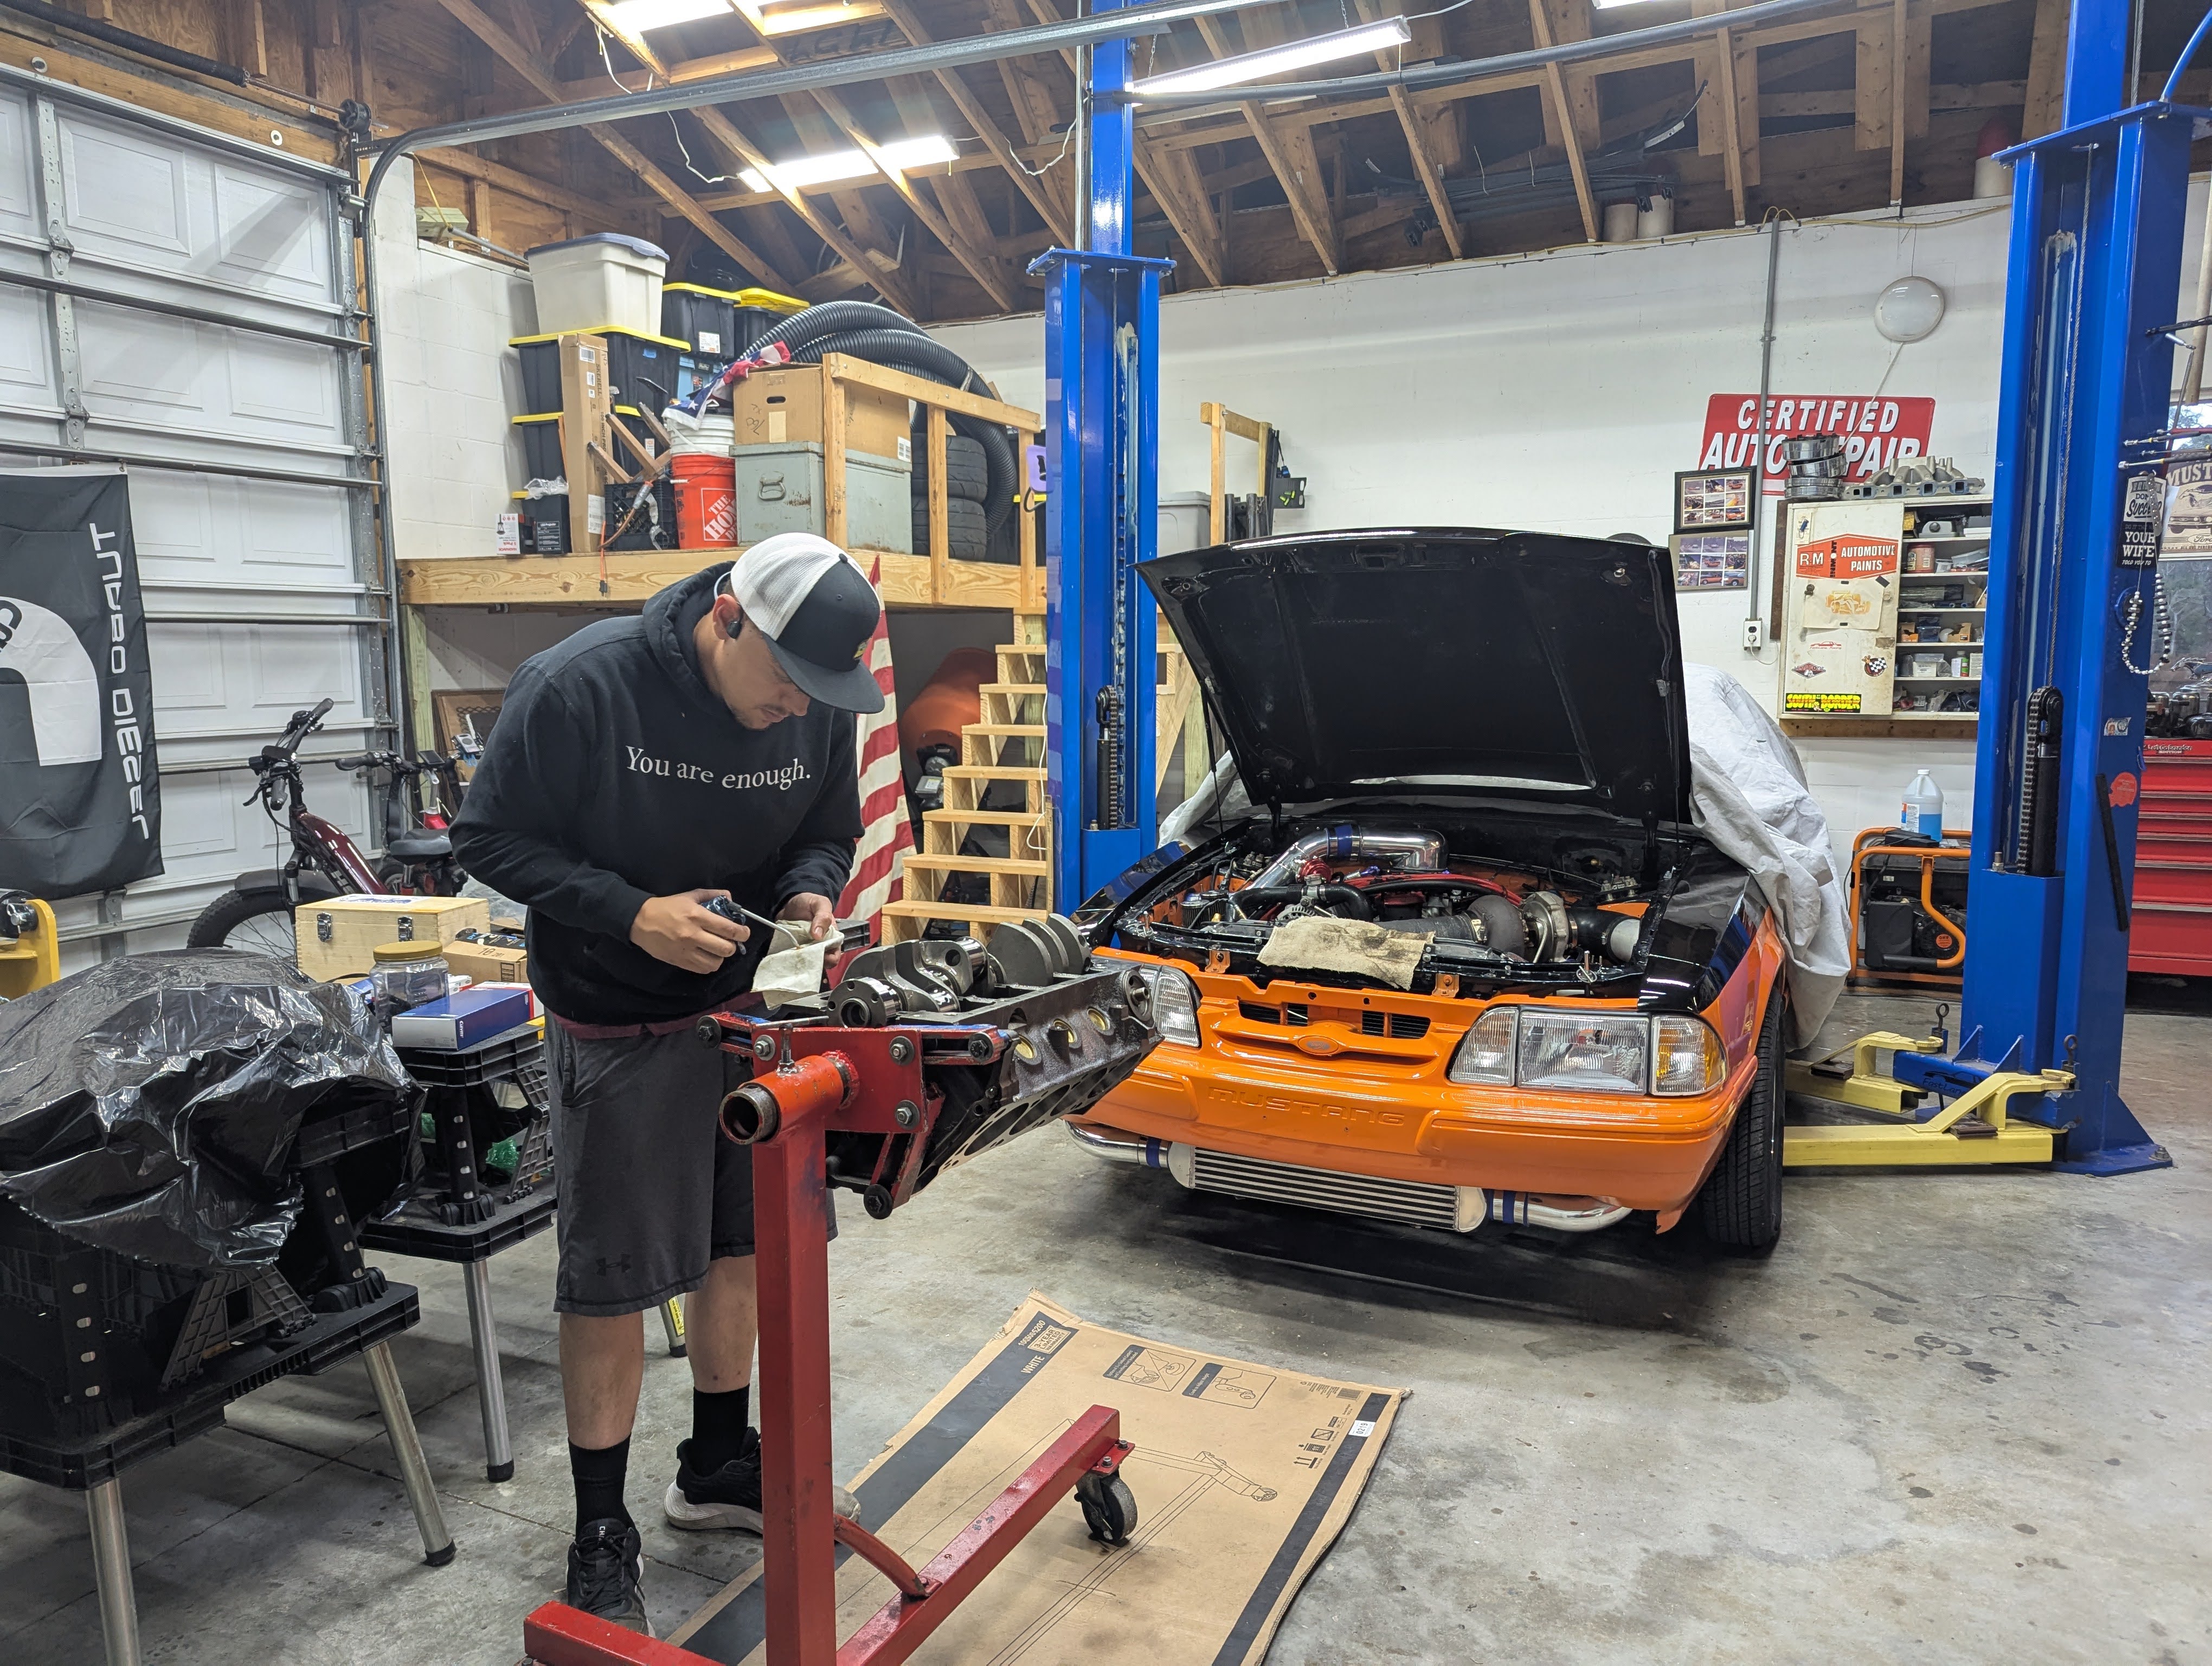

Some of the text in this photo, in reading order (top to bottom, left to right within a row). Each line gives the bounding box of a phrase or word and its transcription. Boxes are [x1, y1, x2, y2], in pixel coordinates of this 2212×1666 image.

[1738, 400, 1899, 432] CERTIFIED
[2165, 463, 2212, 486] MUST
[708, 495, 731, 515] THE
[2125, 531, 2156, 543] YOUR
[1841, 544, 1895, 558] AUTOMOTIVE
[2123, 545, 2155, 558] WIFE
[1851, 560, 1882, 572] PAINTS
[1786, 694, 1816, 708] SOUTH
[1821, 695, 1861, 709] BORDER
[625, 746, 811, 791] You are enough.
[1922, 1078, 1962, 1094] FastLan
[1208, 1086, 1405, 1126] MUSTANG
[1034, 1329, 1056, 1348] 3-YEAR
[1040, 1331, 1060, 1349] LIMITED
[1045, 1332, 1065, 1351] WARRANTY
[1020, 1355, 1045, 1374] WHITE
[1356, 1422, 1368, 1434] 0219
